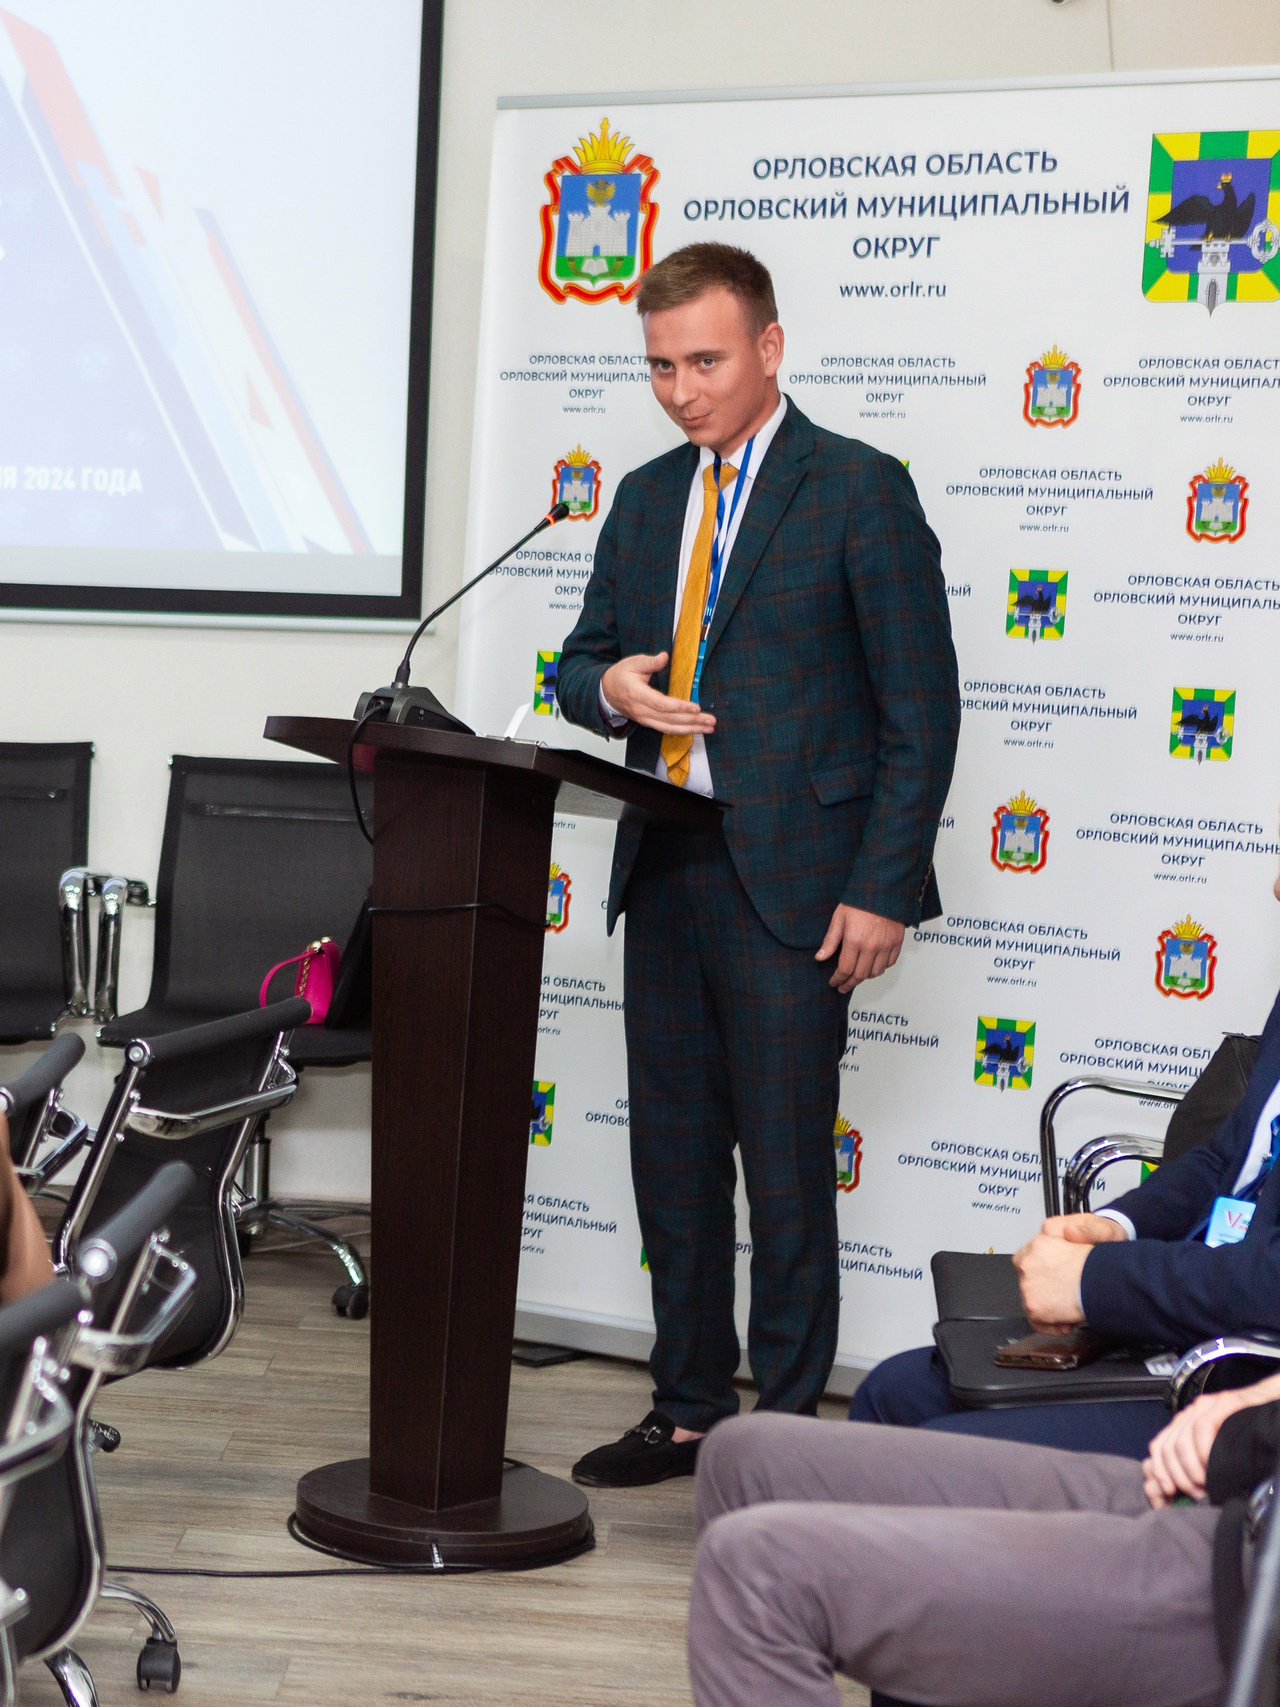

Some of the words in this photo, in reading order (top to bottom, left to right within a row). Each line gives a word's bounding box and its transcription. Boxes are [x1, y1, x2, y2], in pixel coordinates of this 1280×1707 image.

[753, 155, 916, 180] ОРЛОВСКАЯ
[926, 151, 1058, 176] ОБЛАСТЬ
[684, 192, 847, 221] ОРЛОВСКИЙ
[857, 184, 1129, 220] МУНИЦИПАЛЬНЫЙ
[853, 237, 940, 259] ОКРУГ
[839, 281, 947, 298] www.orlr.ru
[529, 355, 596, 366] ОРЛОВСКАЯ
[821, 357, 894, 368] ОРЛОВСКАЯ
[898, 357, 956, 368] ОБЛАСТЬ
[1139, 358, 1220, 370] ОРЛОВСКАЯ
[1224, 358, 1280, 370] ОБЛАСТ
[500, 370, 568, 382] ОРЛОВСКИЙ
[571, 371, 651, 384] МУНИЦИПАЛЬ
[789, 372, 864, 385] ОРЛОВСКИЙ
[867, 373, 987, 386] МУНИЦИПАЛЬНЫЙ
[1103, 375, 1185, 388] ОРЛОВСКИЙ
[1189, 377, 1280, 390] МУНИЦИПАЛ
[569, 388, 605, 399] ОКРУГ
[866, 393, 905, 403] ОКРУГ
[1187, 396, 1232, 407] ОКРУГ
[1180, 414, 1233, 423] www.orlr.ru
[24, 467, 76, 491] 2024
[81, 467, 143, 497] ГОДА
[979, 468, 1056, 480] ОРЛОВСКАЯ
[1060, 469, 1122, 482] ОБЛАСТЬ
[945, 484, 1024, 498] ОРЛОВСКИЙ
[1027, 485, 1154, 501] МУНИЦИПАЛЬНЫЙ
[1026, 505, 1068, 517] ОКРУГ
[515, 551, 581, 563] ОРЛОВСКАЯ
[1127, 575, 1210, 588] ОРЛОВСКАЯ
[555, 586, 585, 596] ОКРУ
[1093, 592, 1175, 606] ОРЛОВСКИЙ
[1179, 595, 1280, 611] МУНИЦИПАЛЬ
[1177, 614, 1223, 626] ОКРУГ
[1170, 632, 1224, 643] www.orlr.ru
[963, 681, 1041, 695] ОРЛОВСКАЯ
[1044, 686, 1106, 699] ОБЛАСТЬ
[1012, 702, 1137, 720] МУНИЦИПАЛЬНЫЙ
[1010, 720, 1053, 732] ОКРУГ
[1109, 813, 1194, 830] ОРЛОВСКАЯ
[1197, 819, 1263, 835] ОБЛАСТЬ
[1076, 829, 1159, 846] ОРЛОВСКИЙ
[1161, 854, 1205, 868] ОКРУГ
[946, 916, 1024, 934] ОРЛОВСКАЯ
[1028, 924, 1088, 940] ОБЛАСТЬ
[913, 931, 992, 949] ОРЛОВСКИЙ
[995, 939, 1121, 962] МУНИЦИПАЛЬНЫЙ
[993, 957, 1035, 971] ОКРУГ
[553, 977, 606, 992] ОБЛАСТЬ
[539, 1009, 559, 1020] РУГ
[851, 1010, 908, 1026] ОБЛАСТЬ
[537, 1027, 561, 1036] orlr.ru
[848, 1027, 939, 1048] ИЦИПАЛЬНЫЙ
[1094, 1038, 1178, 1056] ОРЛОВСКАЯ
[1059, 1052, 1144, 1072] ОРЛОВСКИЙ
[585, 1111, 630, 1127] ОРЛОВС
[931, 1140, 1009, 1160] ОРЛОВСКАЯ
[898, 1154, 976, 1174] ОРЛОВСКИЙ
[978, 1183, 1019, 1198] ОКРУГ
[537, 1195, 590, 1212] ОБЛАСТЬ
[521, 1227, 543, 1238] РУГ
[841, 1259, 923, 1281] ЦИПАЛЬНЫЙ
